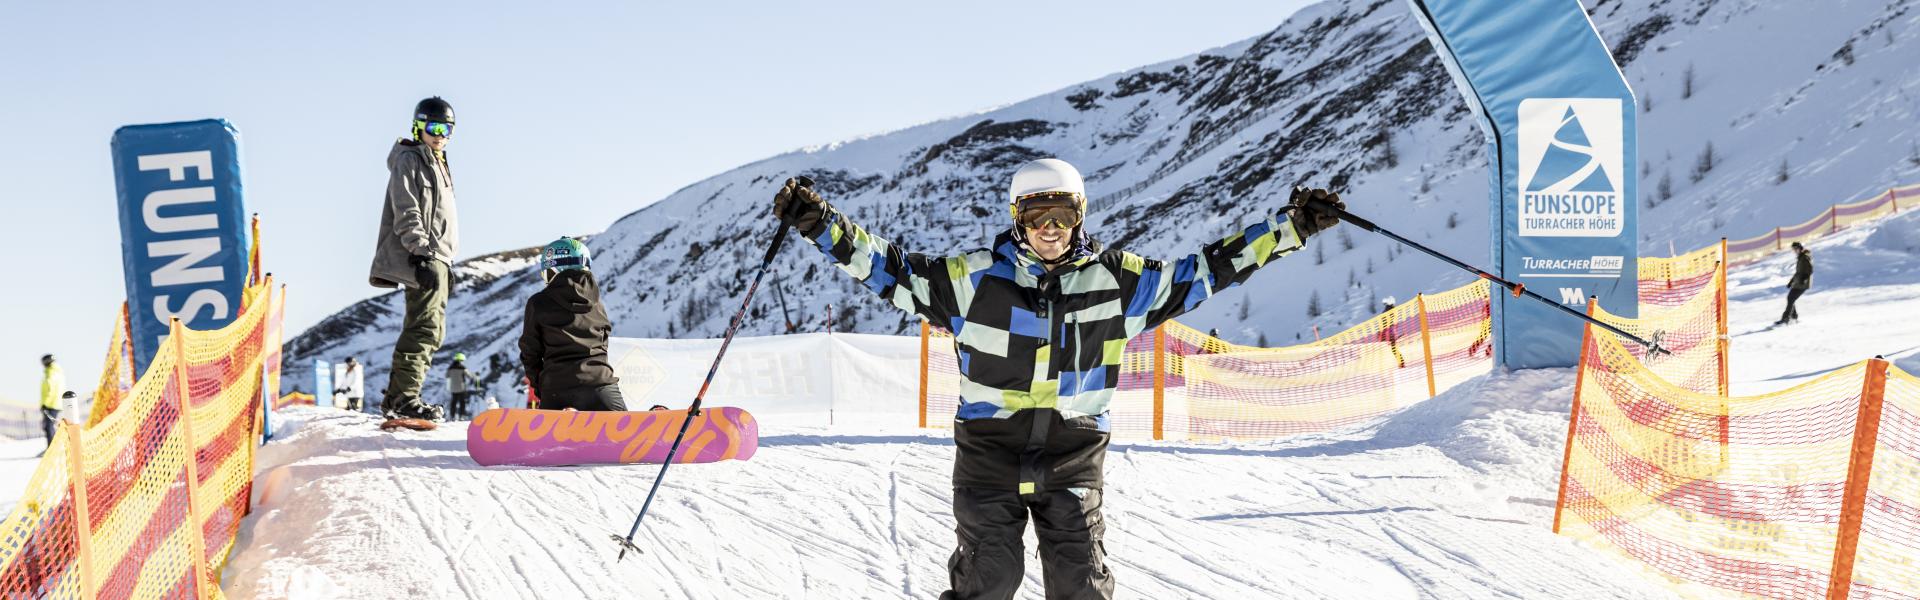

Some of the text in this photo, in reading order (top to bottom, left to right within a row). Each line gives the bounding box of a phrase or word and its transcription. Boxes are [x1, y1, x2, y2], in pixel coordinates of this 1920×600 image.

[1524, 194, 1616, 214] FUNSLOPE
[1525, 215, 1616, 230] TURRACHER HÖHE
[137, 150, 229, 347] FUNS
[1522, 257, 1620, 270] TURRACHER HÖHE
